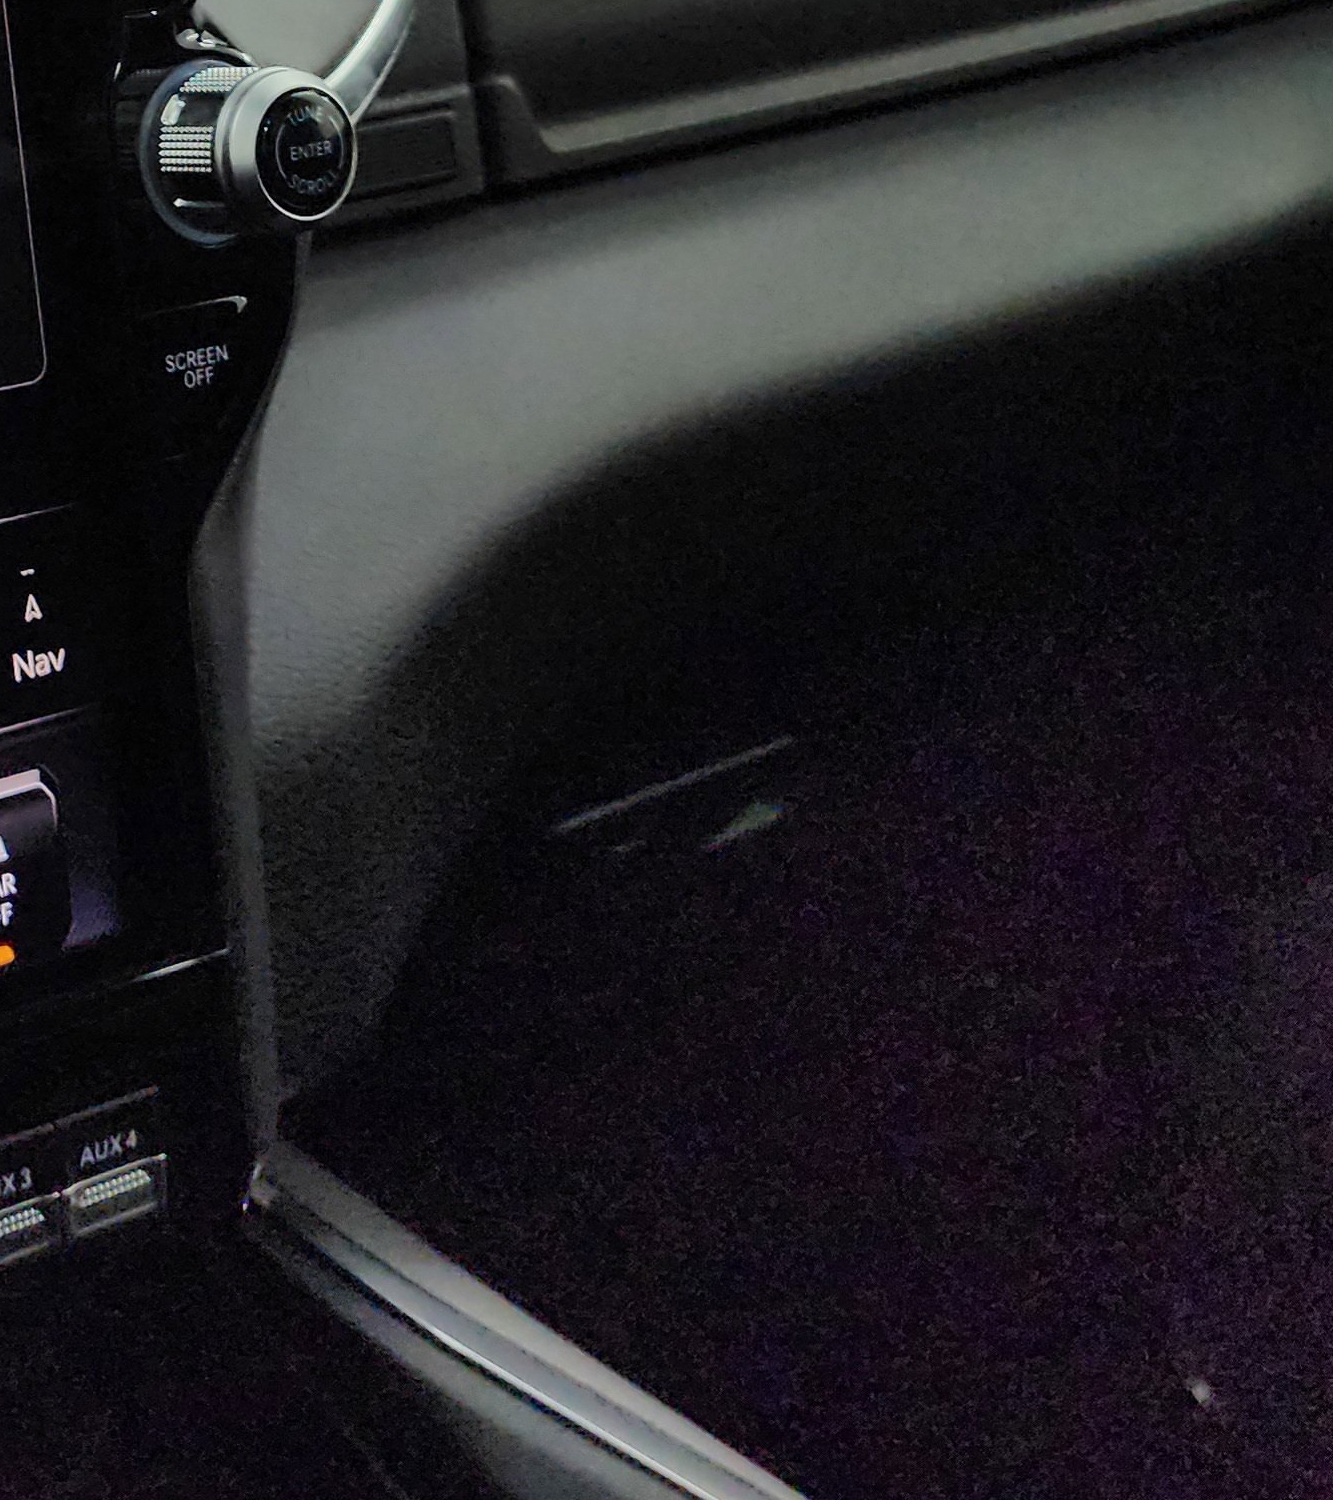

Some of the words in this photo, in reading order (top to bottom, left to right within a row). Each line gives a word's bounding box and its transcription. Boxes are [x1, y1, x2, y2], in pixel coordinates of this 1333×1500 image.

[290, 141, 333, 161] ENTER
[165, 345, 229, 373] SCREEN
[183, 366, 214, 389] OFF
[12, 649, 66, 682] Nav
[80, 1134, 121, 1168] AUX
[22, 1167, 32, 1190] 3
